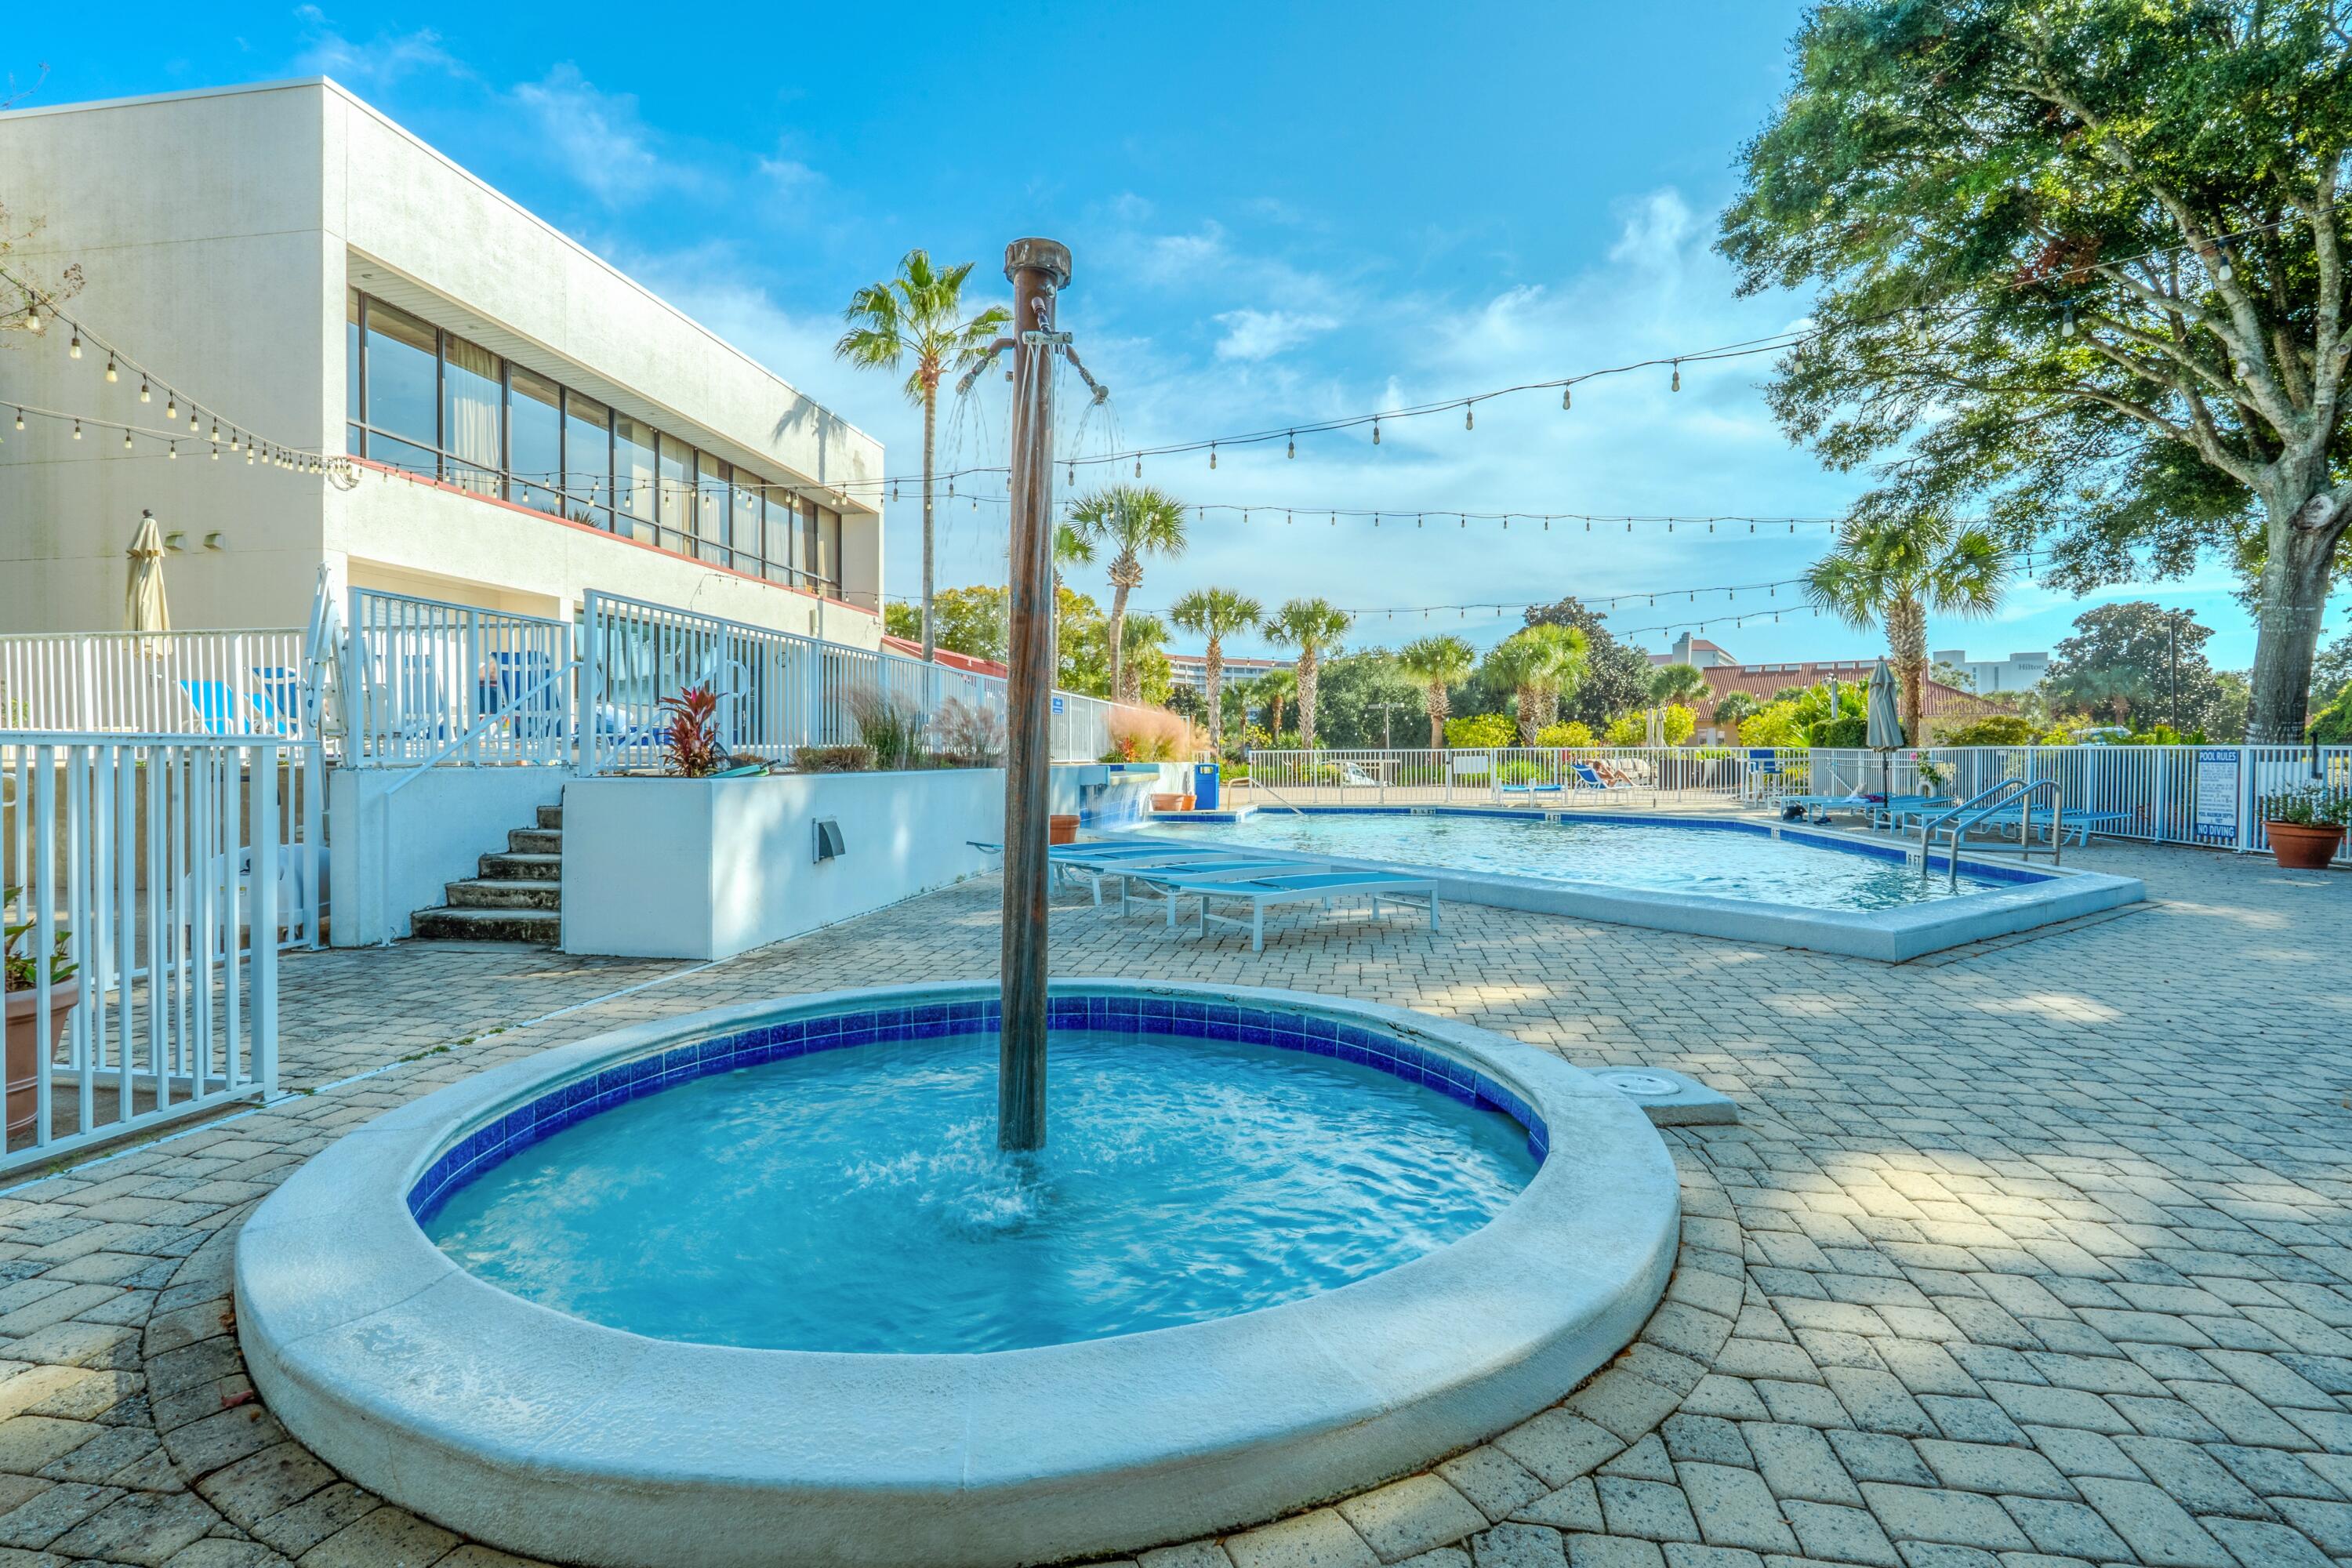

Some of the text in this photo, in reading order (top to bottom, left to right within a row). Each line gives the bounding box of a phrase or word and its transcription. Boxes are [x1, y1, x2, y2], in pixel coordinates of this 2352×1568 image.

[2199, 752, 2237, 761] POOL RULES
[2198, 824, 2234, 837] NO DIVING
[1914, 855, 1921, 866] FT
